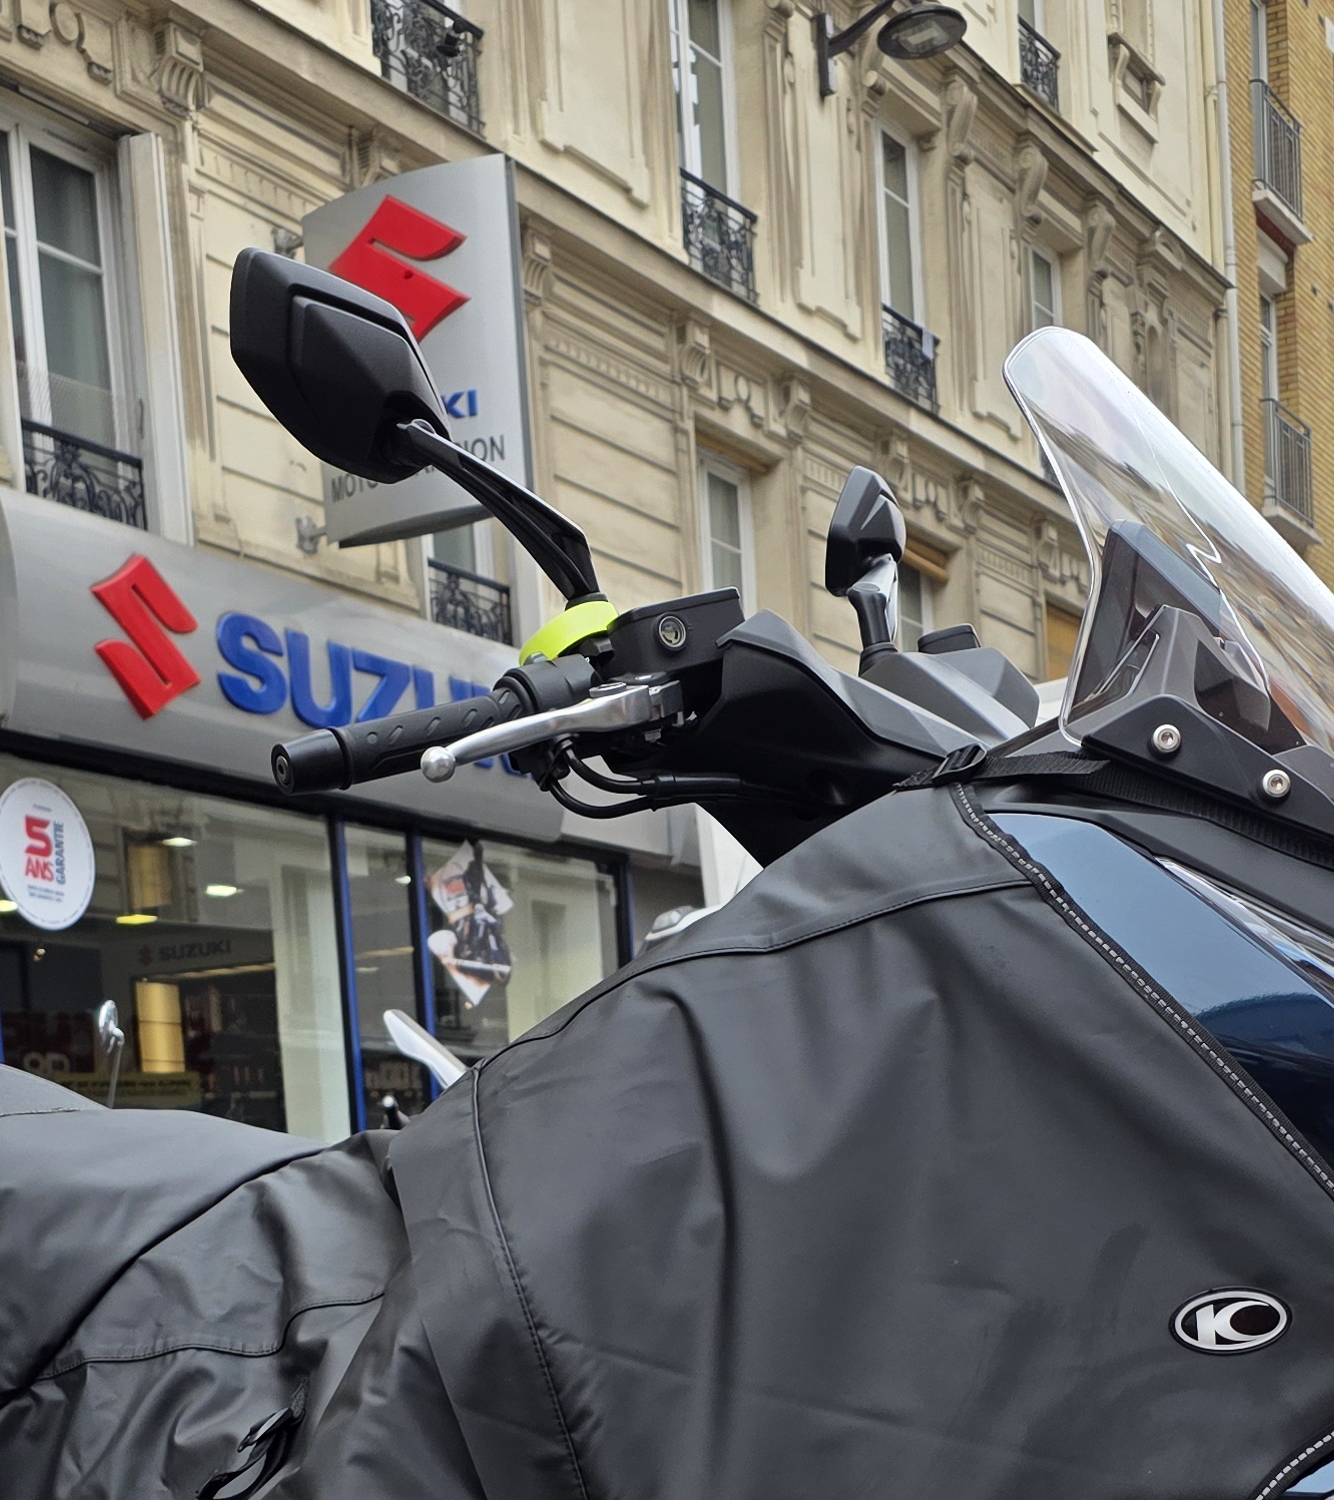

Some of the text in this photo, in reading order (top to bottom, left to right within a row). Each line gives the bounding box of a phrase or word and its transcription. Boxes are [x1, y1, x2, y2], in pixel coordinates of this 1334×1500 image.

[25, 814, 53, 858] 5
[54, 819, 66, 885] GARANTIE
[24, 857, 54, 882] ANS
[158, 939, 232, 961] SUZUKI
